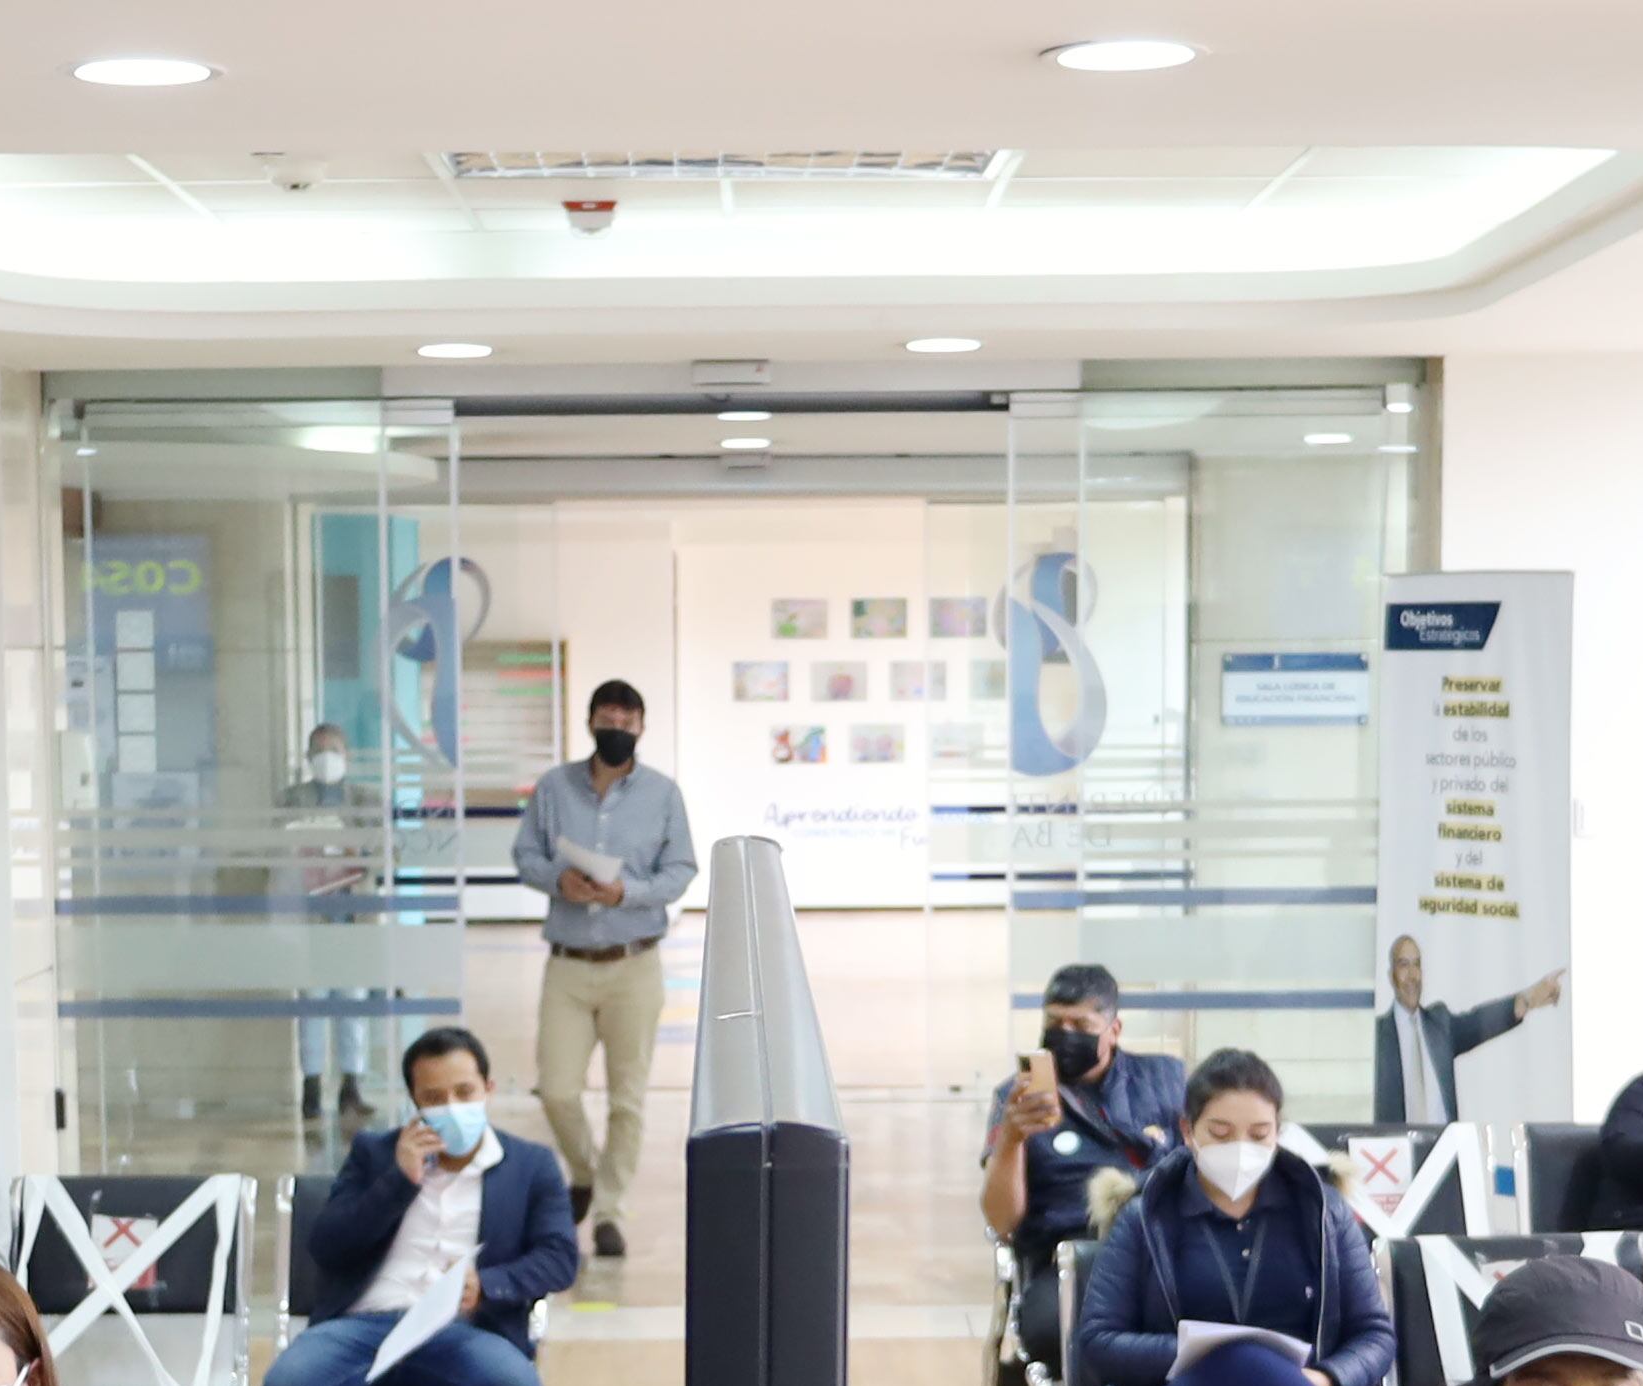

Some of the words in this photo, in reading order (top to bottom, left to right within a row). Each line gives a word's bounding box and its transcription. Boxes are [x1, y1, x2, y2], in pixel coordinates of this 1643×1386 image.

[1400, 609, 1454, 630] Objetivos
[1442, 676, 1501, 692] Preservar
[1443, 701, 1510, 717] estabilidad
[1452, 725, 1469, 741] de
[1471, 726, 1488, 742] los
[1425, 752, 1471, 766] sectores
[1473, 750, 1517, 769] público
[1440, 776, 1486, 794] privado
[1490, 776, 1510, 793] del
[1446, 800, 1495, 817] sistema
[1438, 822, 1502, 842] financiero
[1455, 851, 1463, 868] y
[1465, 849, 1483, 866] del
[1434, 873, 1482, 889] sistema
[1487, 875, 1505, 891] de
[1419, 897, 1478, 915] seguridad
